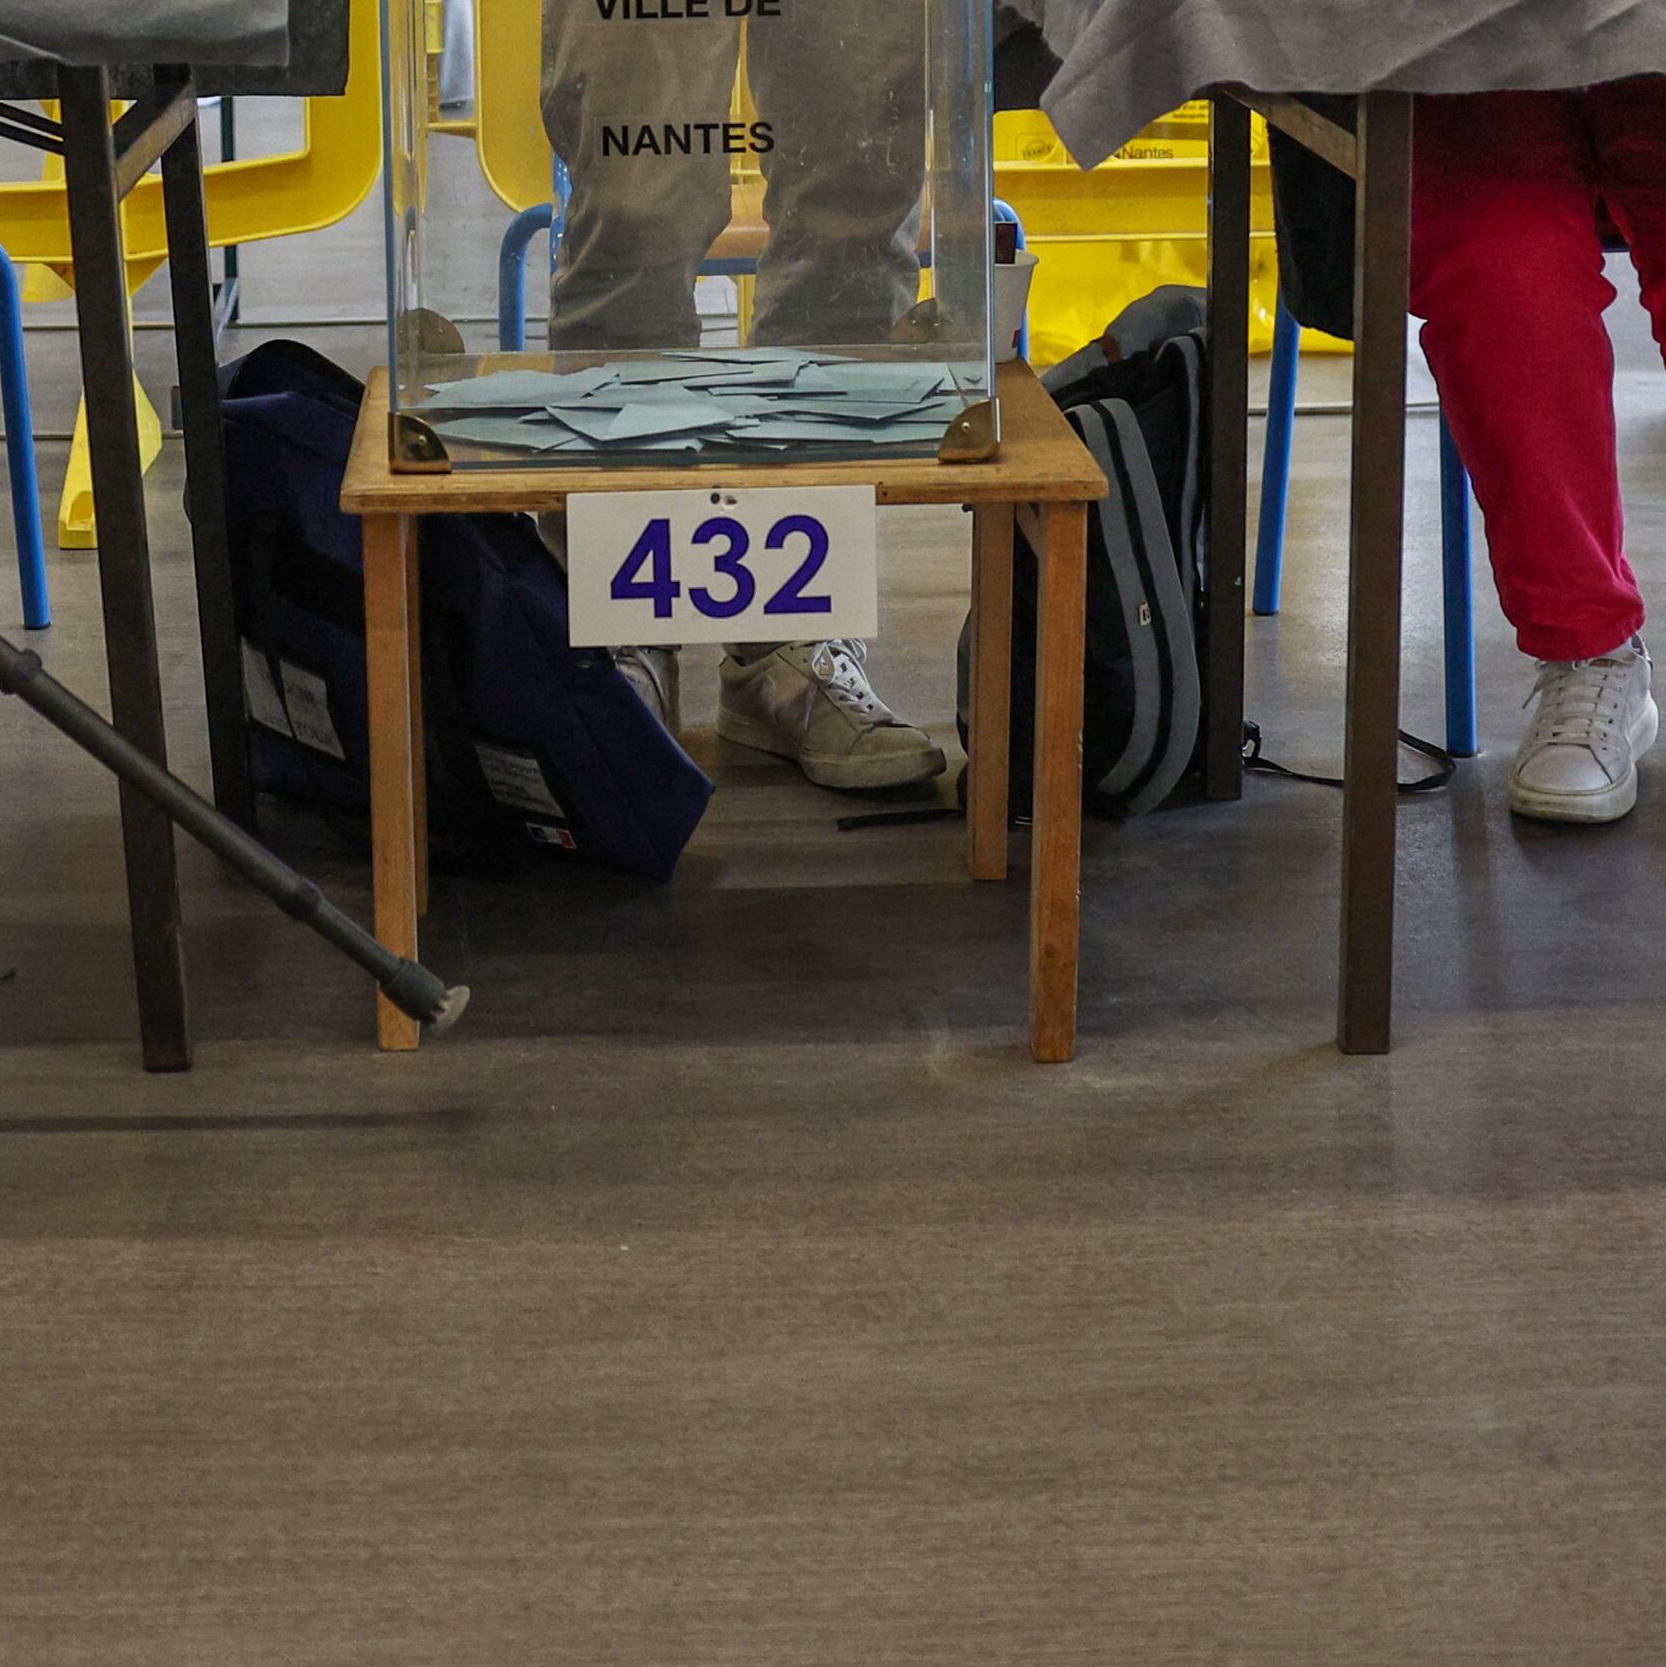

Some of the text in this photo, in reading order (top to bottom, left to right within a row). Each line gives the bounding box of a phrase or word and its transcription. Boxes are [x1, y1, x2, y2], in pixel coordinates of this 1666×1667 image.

[602, 122, 775, 156] NANTES
[1122, 146, 1174, 159] Nantes
[610, 514, 832, 619] 432
